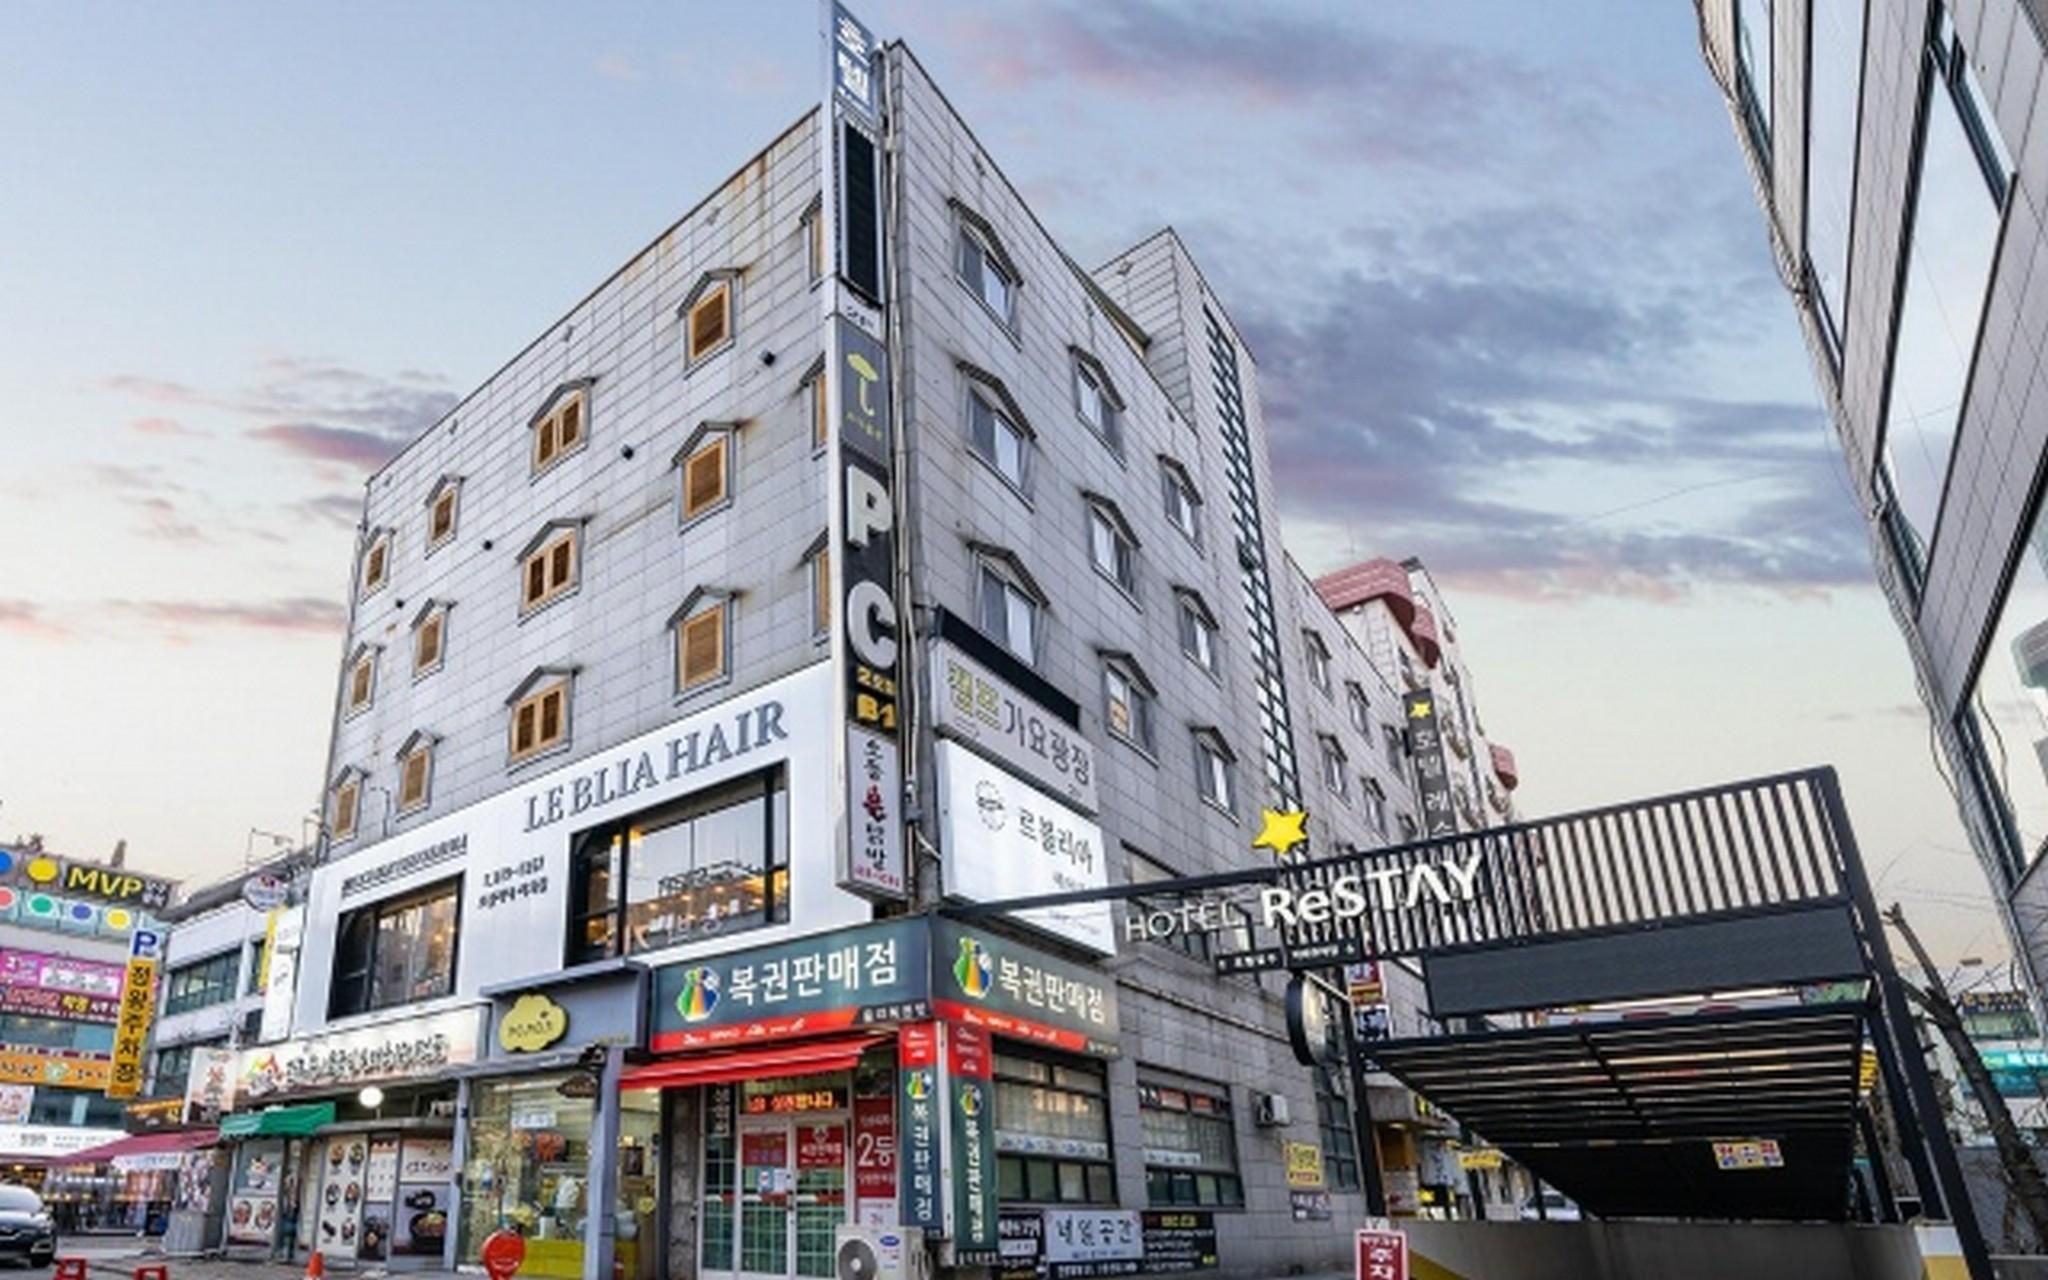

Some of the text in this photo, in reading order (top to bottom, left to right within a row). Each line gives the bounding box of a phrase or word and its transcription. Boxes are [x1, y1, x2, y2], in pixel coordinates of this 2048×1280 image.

[665, 700, 788, 780] HAIR
[857, 693, 896, 728] B1
[68, 866, 144, 898] MVP
[1125, 853, 1482, 941] HOTEL ReSTAY
[132, 930, 157, 956] P
[728, 938, 898, 1005] 복권판매점
[115, 965, 152, 1082] 정왕주차장
[999, 956, 1105, 1024] 복권판매점
[912, 1102, 933, 1222] 복권판매점
[964, 1118, 985, 1244] 복권판매점
